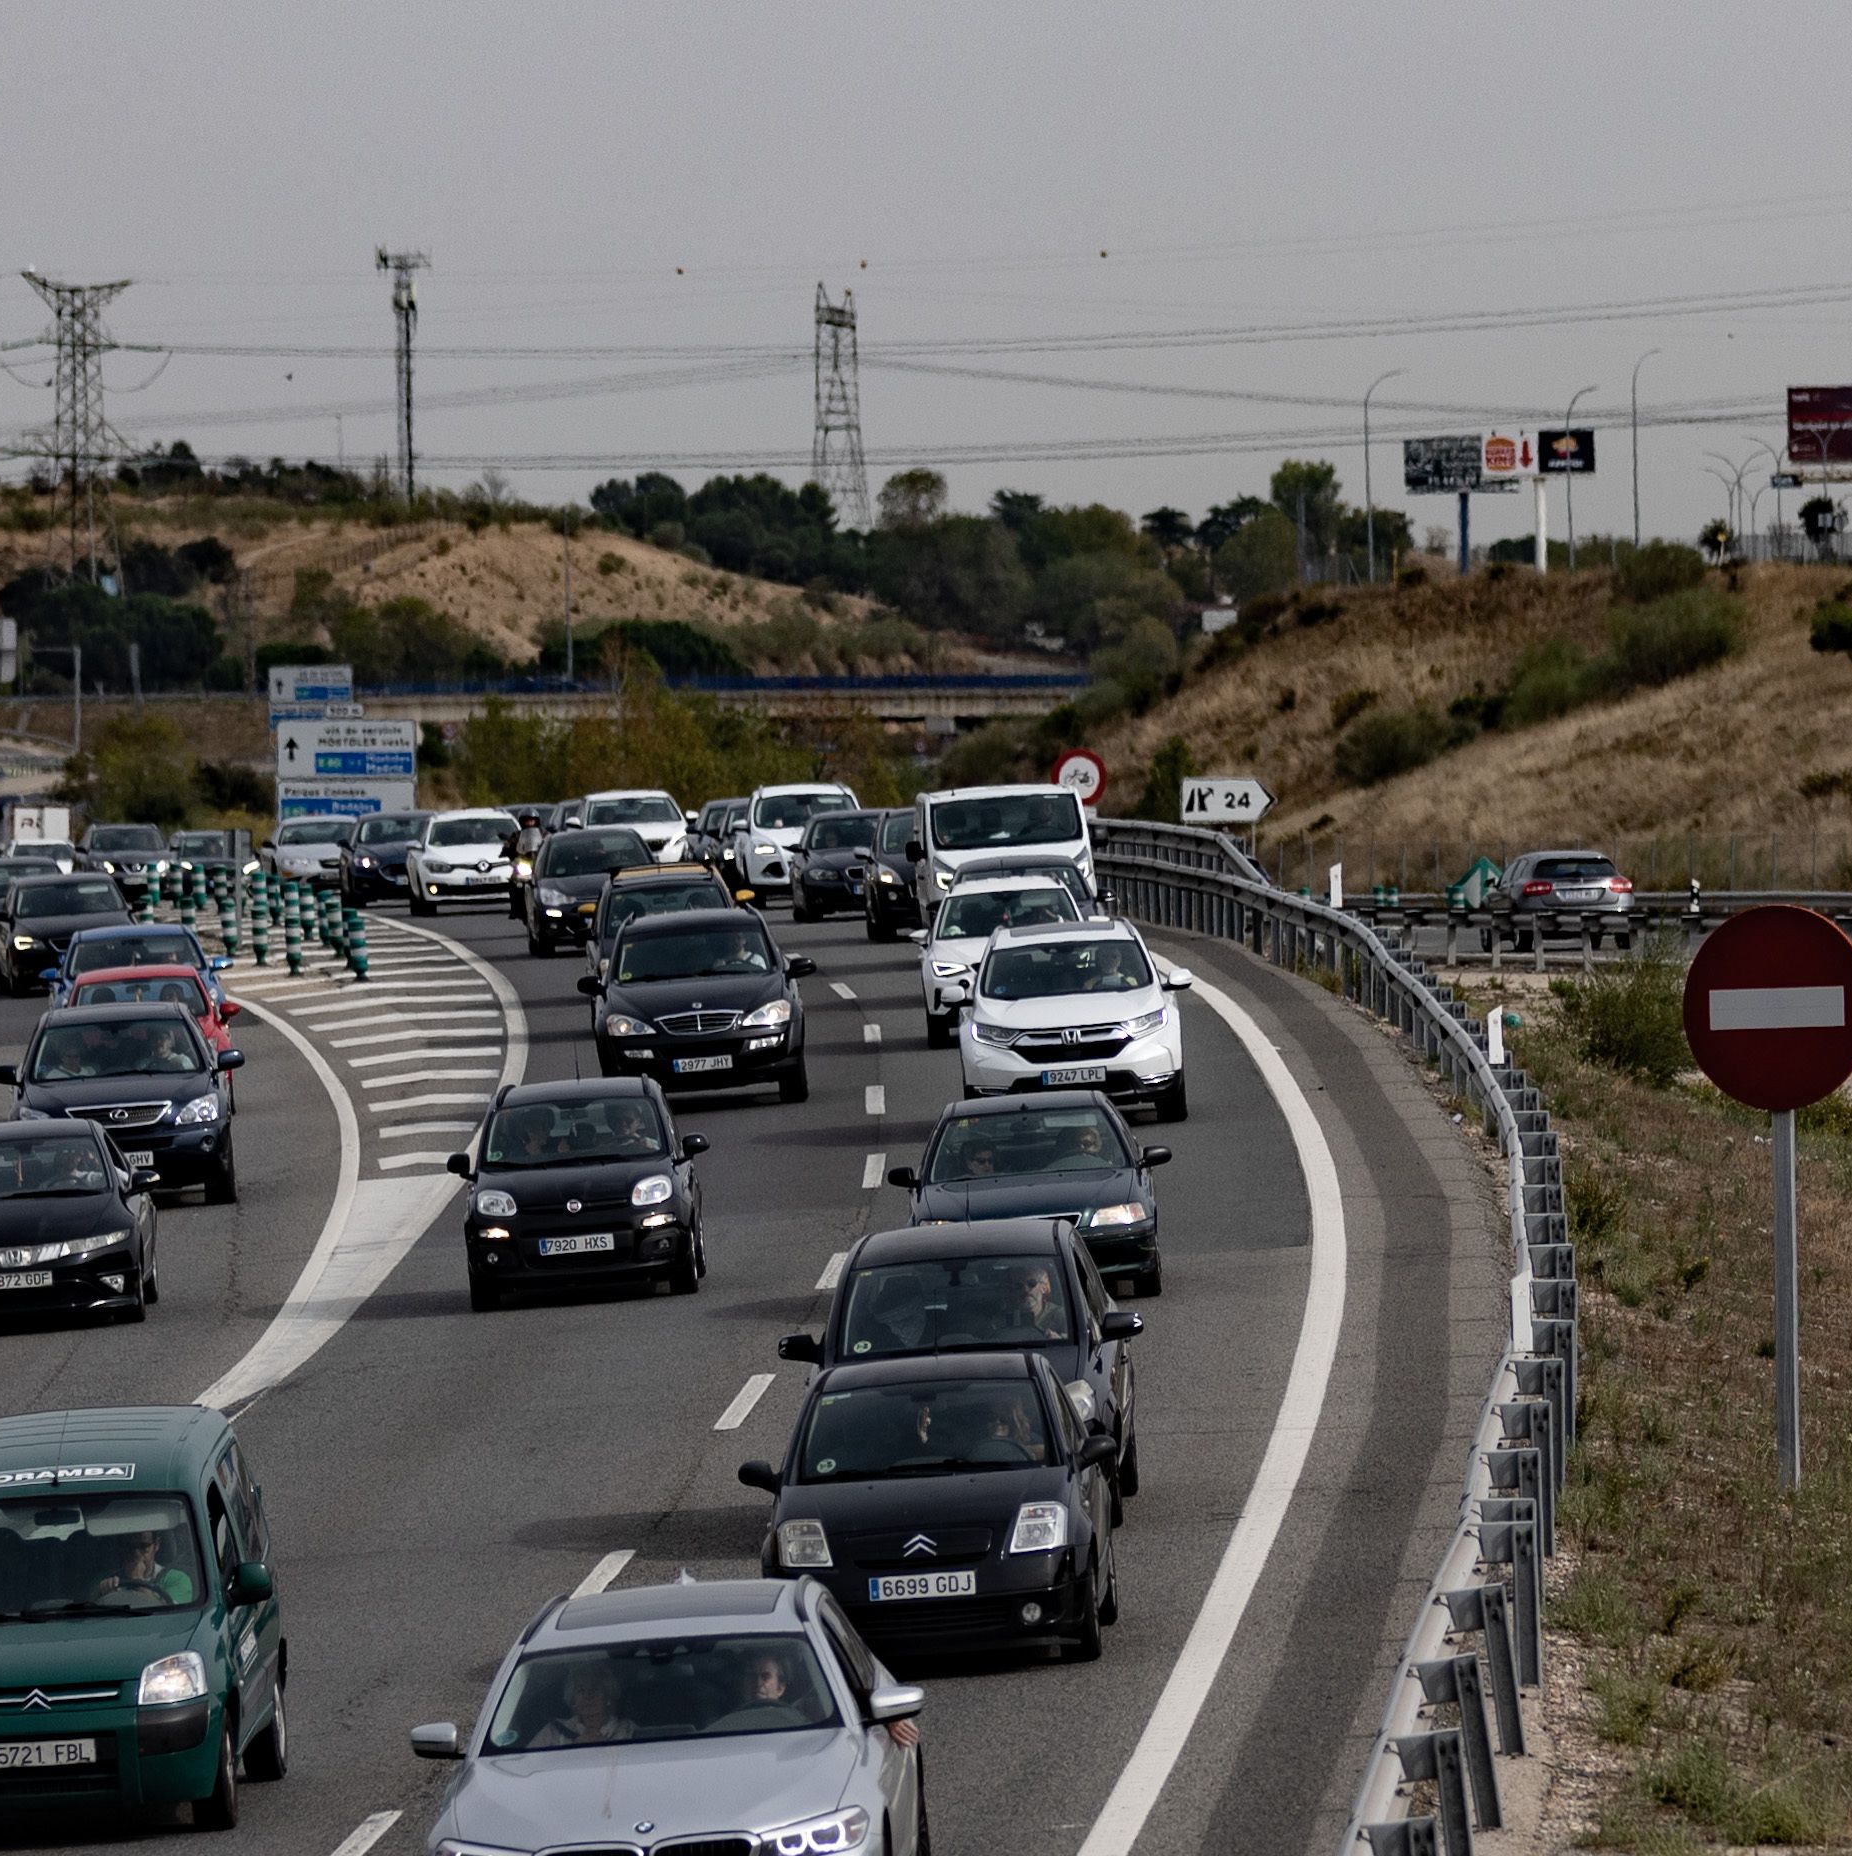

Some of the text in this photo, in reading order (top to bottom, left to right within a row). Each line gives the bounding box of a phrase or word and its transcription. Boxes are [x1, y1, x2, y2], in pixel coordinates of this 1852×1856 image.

[1225, 791, 1251, 809] 24
[681, 1059, 706, 1070] 2977
[1049, 1069, 1102, 1083] 9247 LPL
[547, 1236, 608, 1252] 7920 HXS
[882, 1574, 971, 1597] 6699 GDJ
[54, 1743, 91, 1763] FBL
